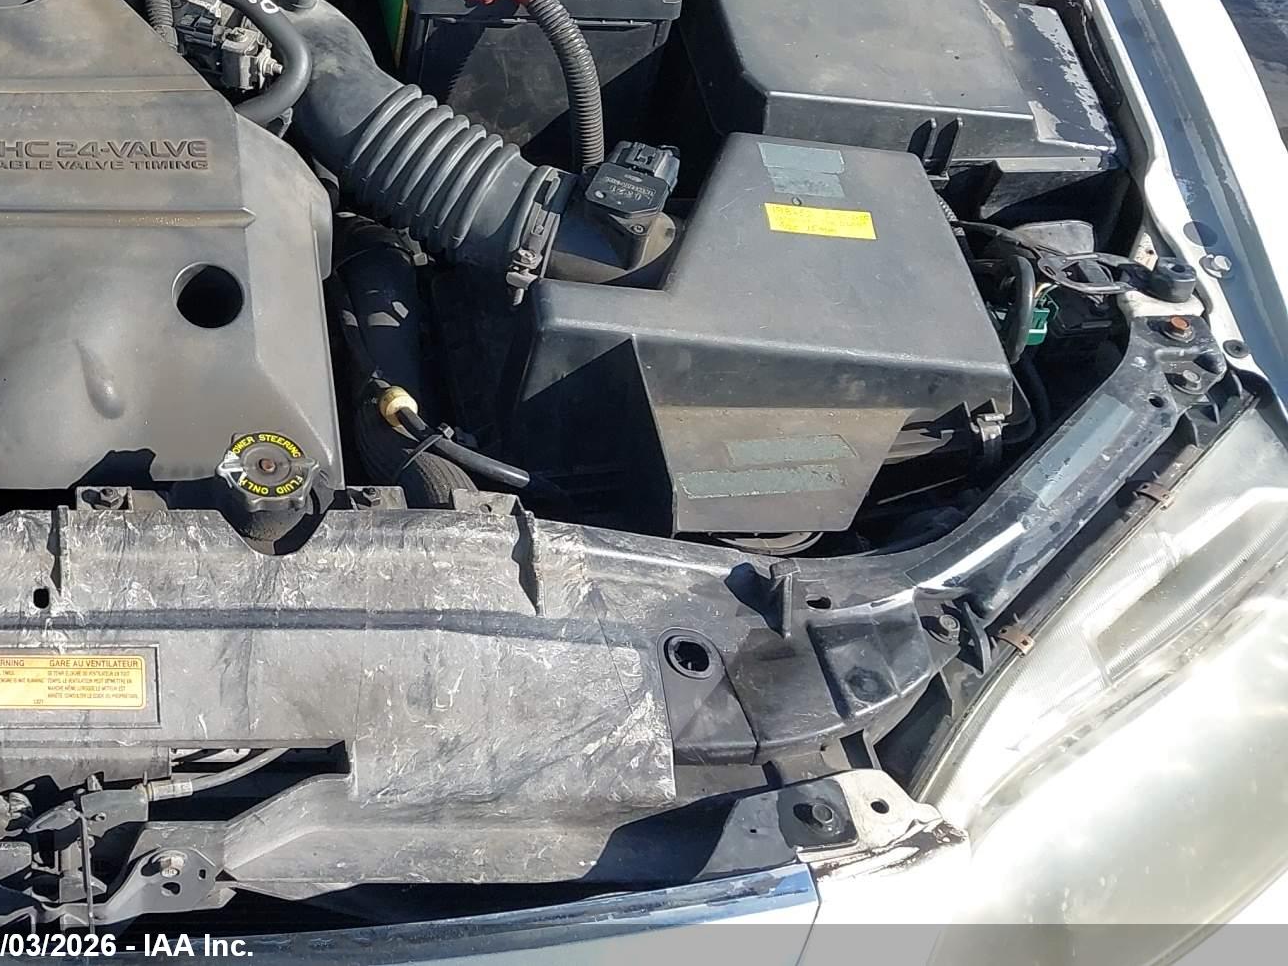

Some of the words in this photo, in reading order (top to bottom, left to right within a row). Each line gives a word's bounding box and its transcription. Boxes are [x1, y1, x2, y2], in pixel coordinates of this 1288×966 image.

[55, 140, 209, 159] 24-VALVE
[57, 159, 125, 170] VALVE
[129, 159, 209, 170] TIMING
[258, 433, 301, 458] STEERING
[276, 475, 303, 495] FLUID
[49, 659, 71, 667] GARE
[72, 659, 84, 667] AU
[85, 659, 138, 668] VENTILATEUR
